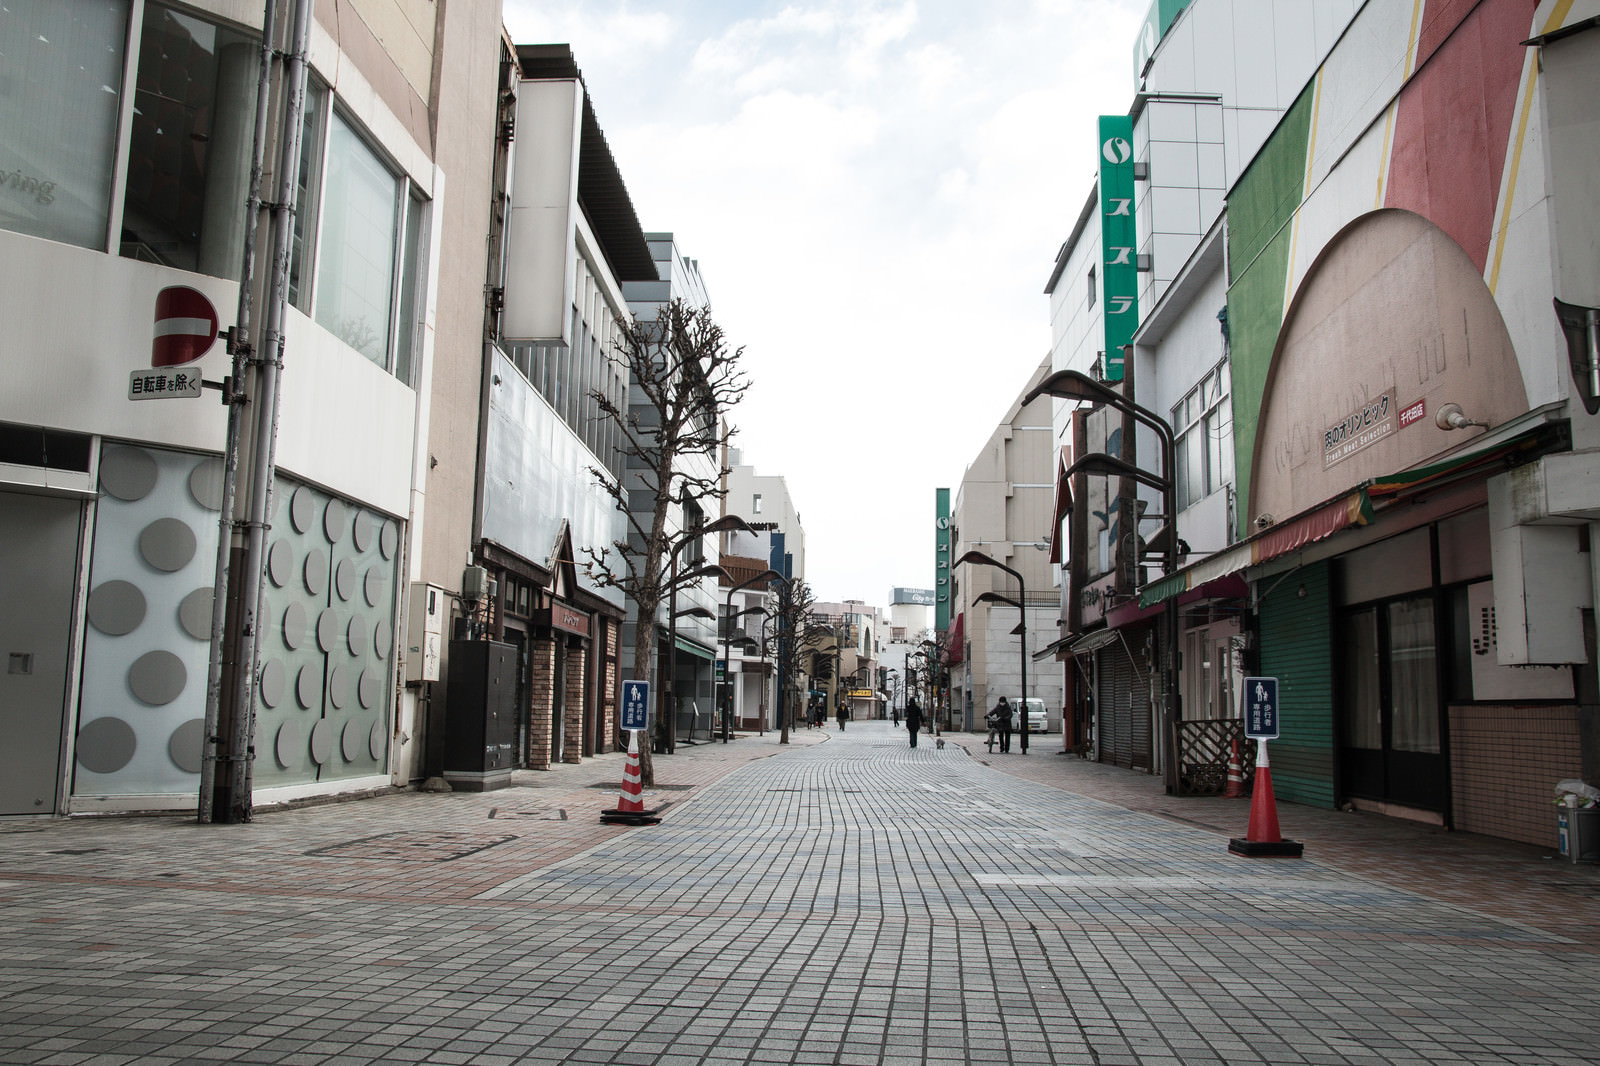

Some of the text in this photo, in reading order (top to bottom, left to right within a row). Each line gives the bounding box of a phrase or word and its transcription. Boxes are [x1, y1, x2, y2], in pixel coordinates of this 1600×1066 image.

[132, 373, 196, 394] 自転車を除く
[1324, 394, 1389, 450] 肉のオリンピック
[1400, 403, 1424, 425] 千代田店
[1326, 423, 1391, 465] Fresh Meat Selection
[1252, 703, 1261, 731] 専用道路
[1263, 703, 1272, 727] 歩行者
